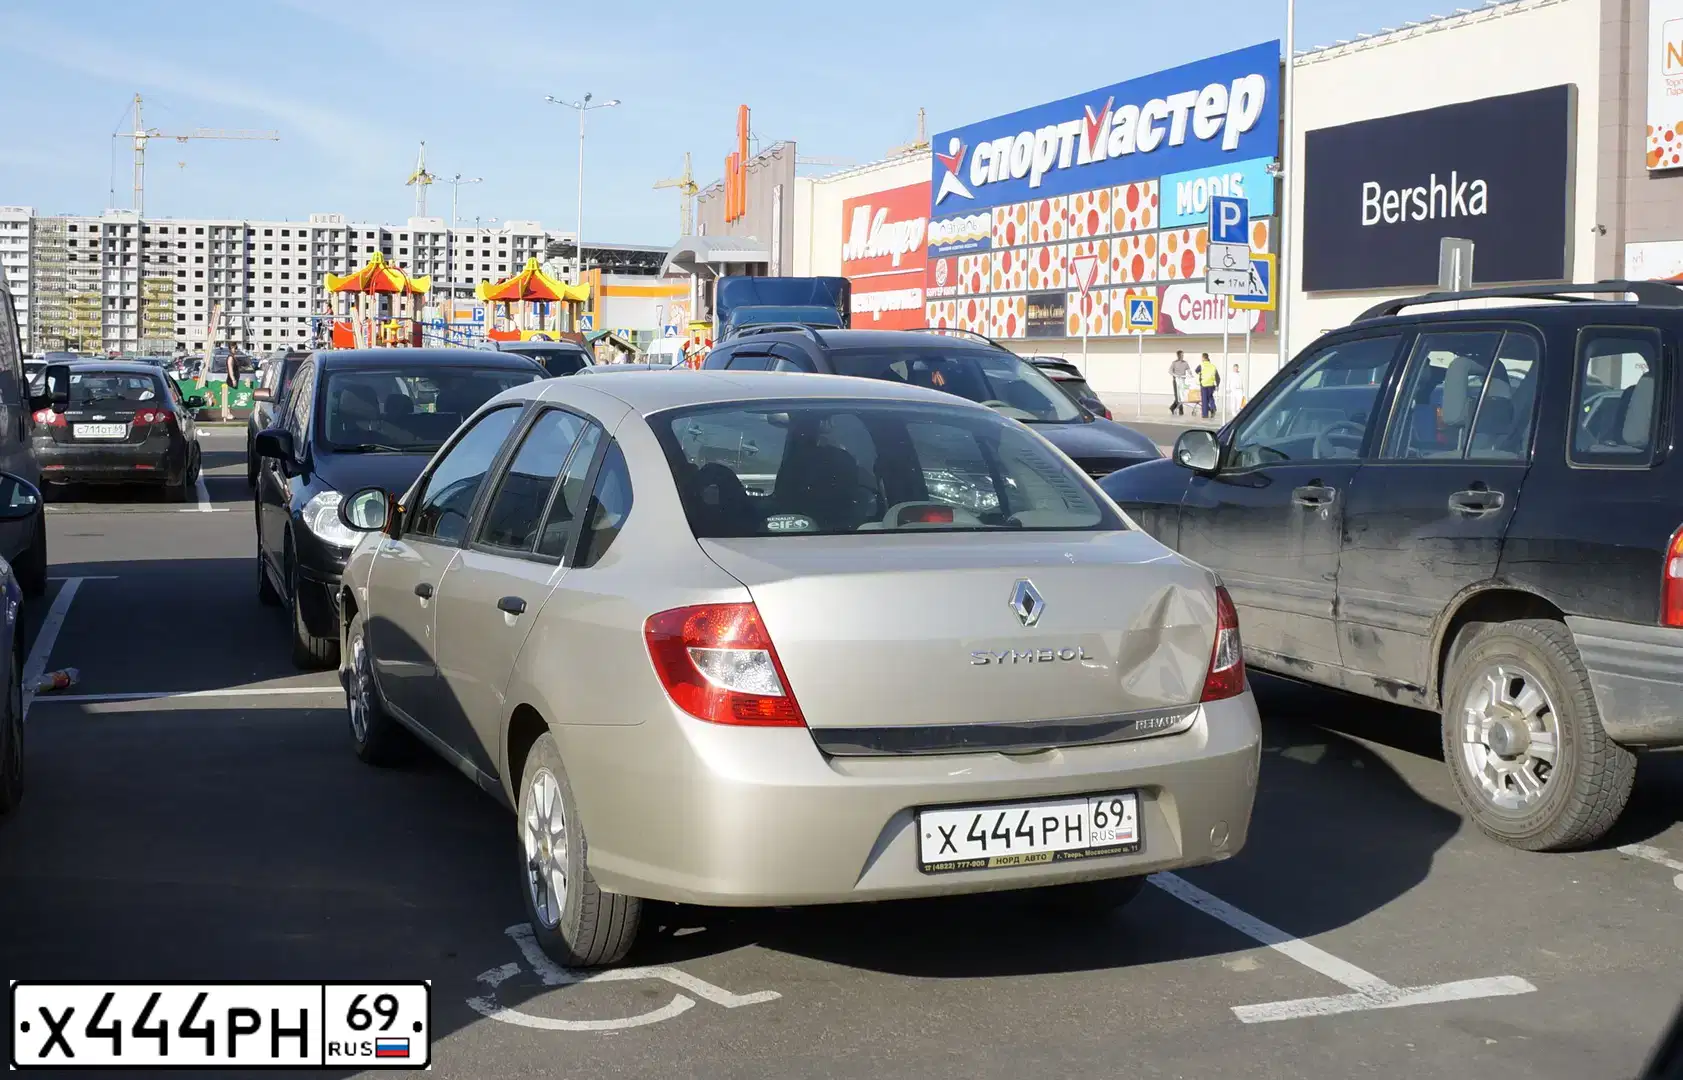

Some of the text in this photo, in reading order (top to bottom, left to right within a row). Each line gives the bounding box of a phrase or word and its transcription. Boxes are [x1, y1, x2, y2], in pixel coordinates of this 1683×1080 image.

[1176, 172, 1244, 216] MODIS
[1362, 171, 1487, 226] Bershka
[1220, 201, 1241, 238] P
[970, 646, 1093, 665] SYMBOL
[1093, 799, 1124, 829] 69
[1091, 829, 1115, 842] RUS
[996, 856, 1020, 865] НОРД
[1024, 853, 1047, 862] АВТО
